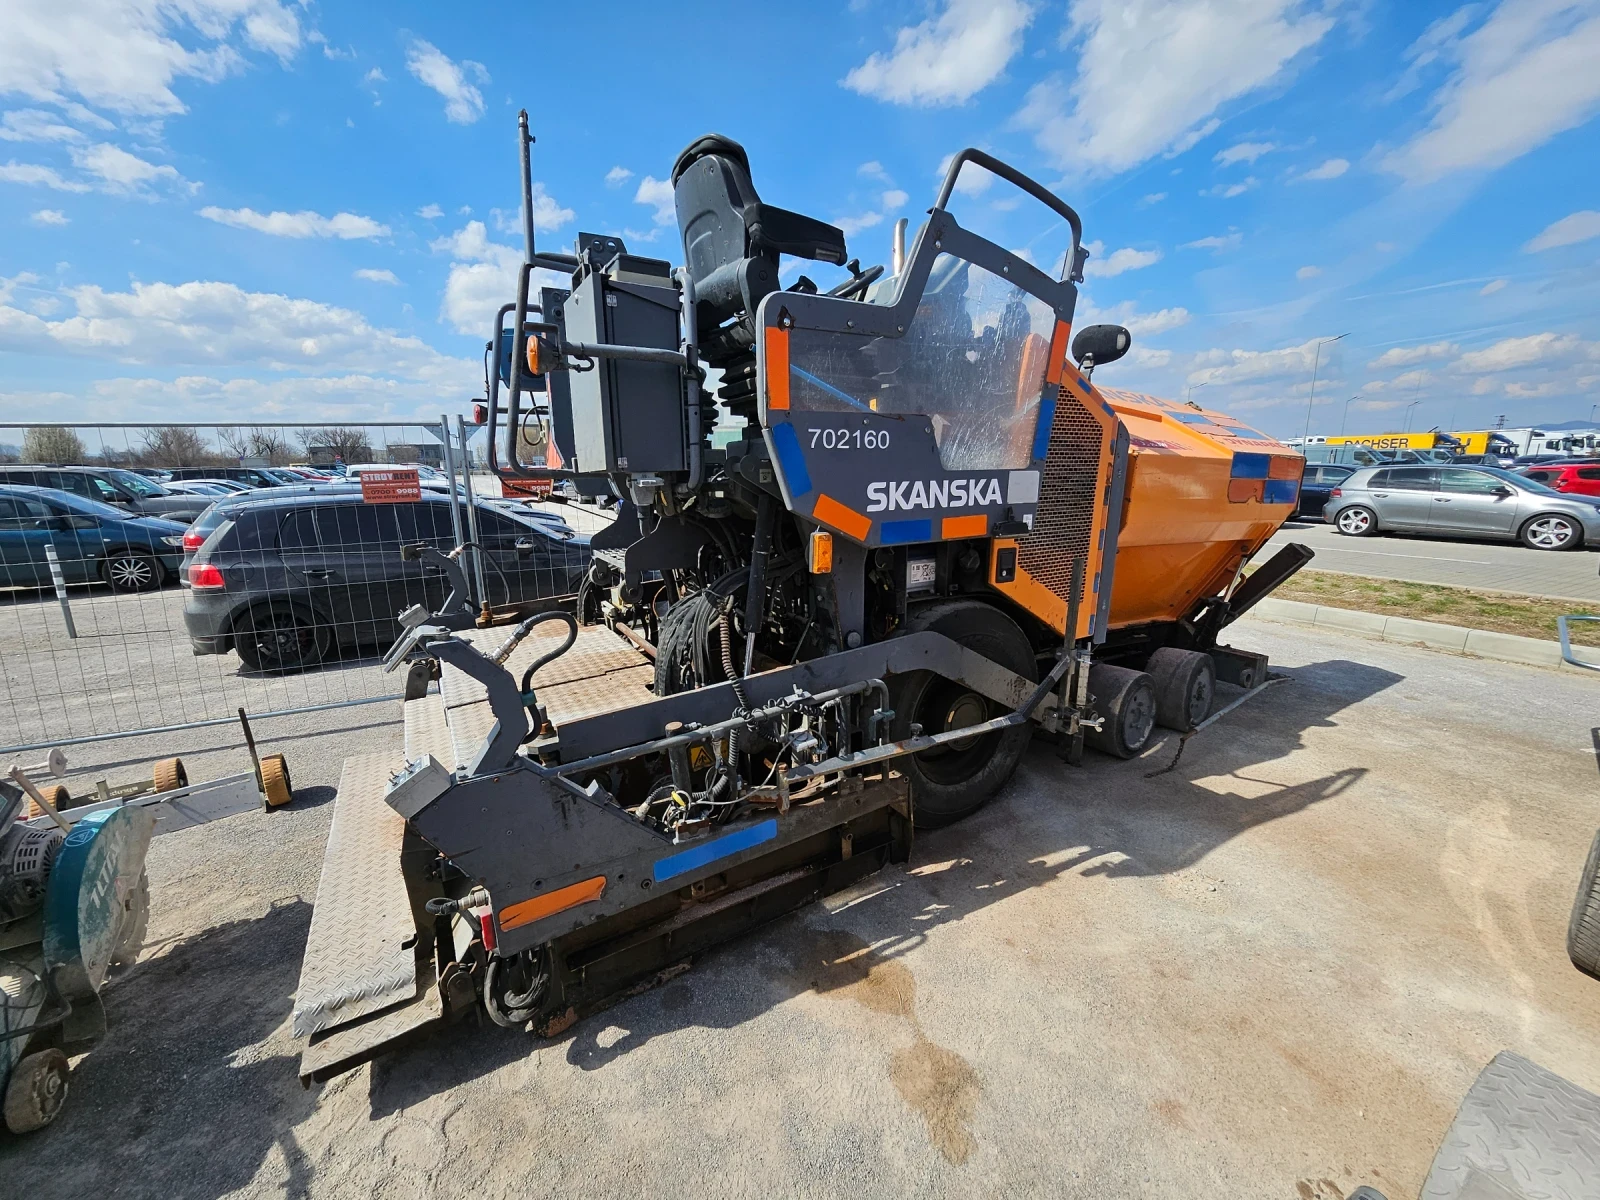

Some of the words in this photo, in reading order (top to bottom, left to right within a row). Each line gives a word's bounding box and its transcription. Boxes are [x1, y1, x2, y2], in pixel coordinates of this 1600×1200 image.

[807, 428, 890, 450] 702160
[362, 472, 416, 482] STROYRENT
[866, 478, 1003, 513] SKANSKA
